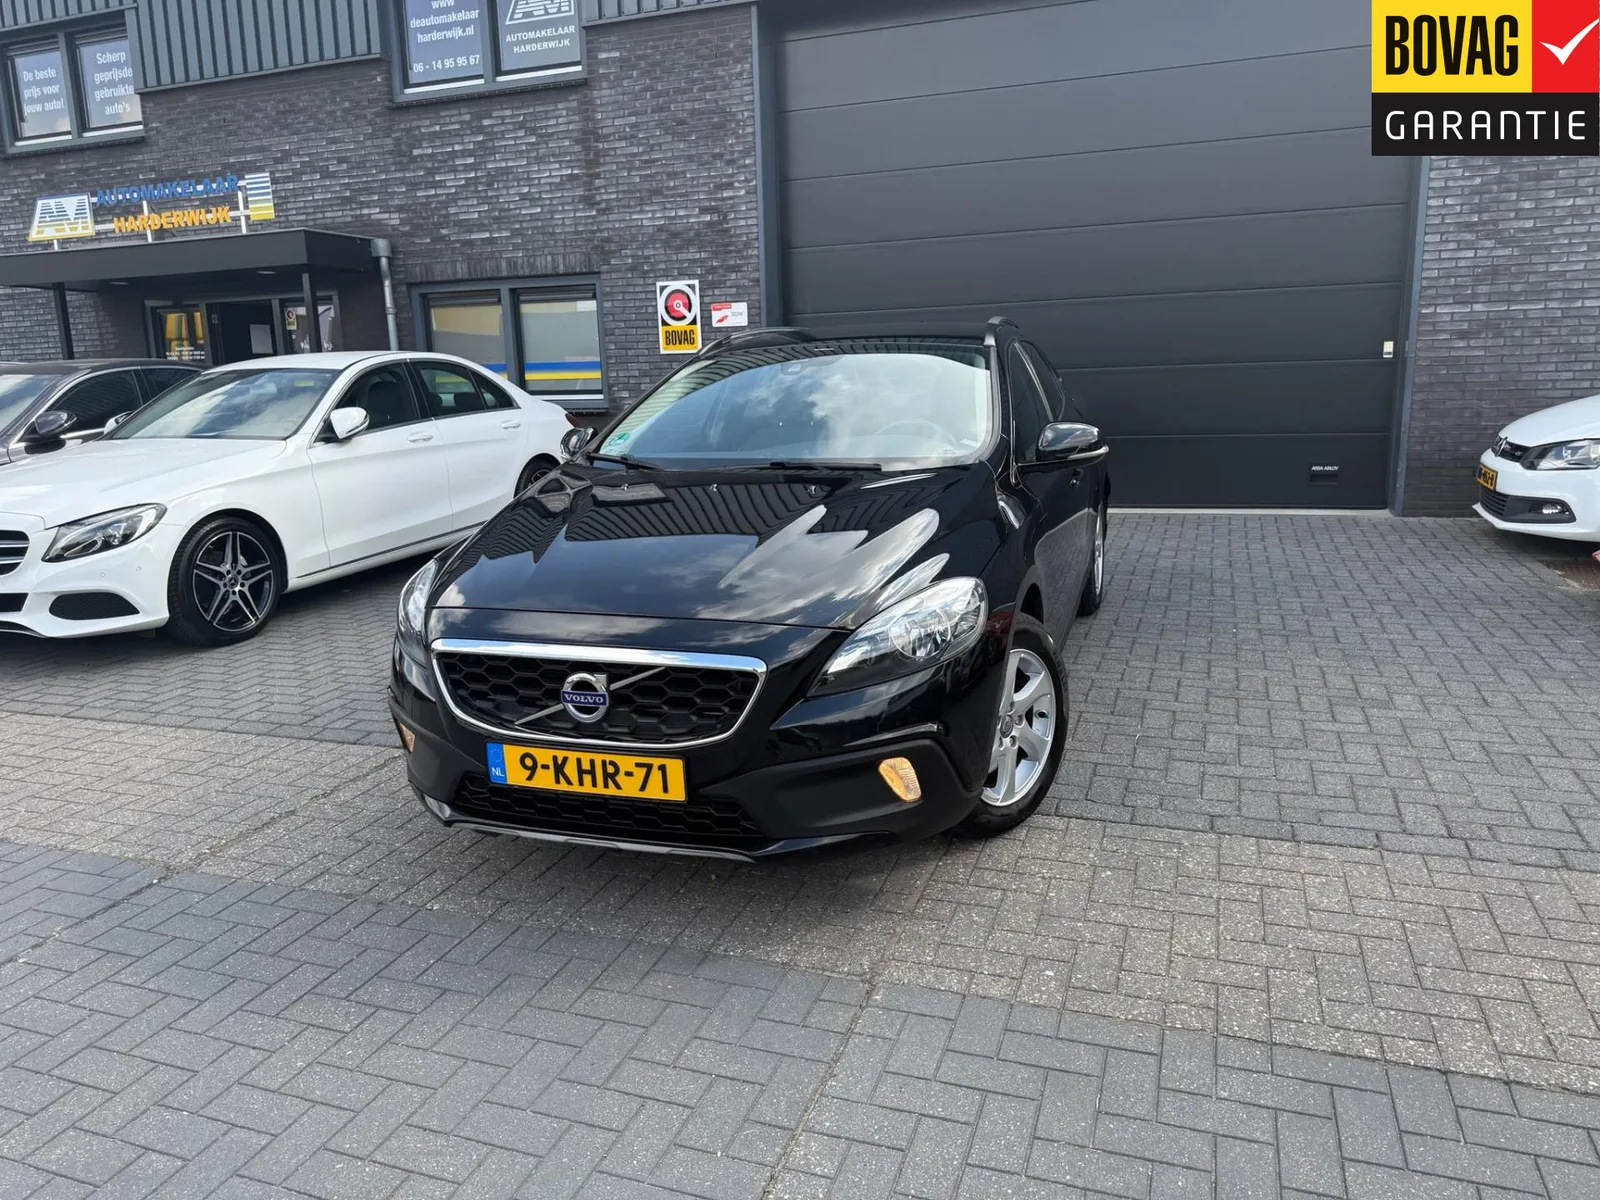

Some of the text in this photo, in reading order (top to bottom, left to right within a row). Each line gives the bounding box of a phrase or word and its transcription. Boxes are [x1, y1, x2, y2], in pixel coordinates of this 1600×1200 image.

[431, 0, 455, 9] www
[410, 9, 480, 28] deautomakelaar
[417, 24, 475, 43] harderwijk.nl
[506, 25, 576, 43] AUTOMAKELAAR
[513, 38, 571, 54] HARDERWIJK
[96, 51, 126, 65] Scherp
[413, 62, 424, 73] 06
[432, 60, 443, 71] 14
[444, 58, 455, 69] 95
[456, 56, 468, 67] 95
[469, 54, 480, 65] 67
[23, 67, 56, 82] De beste
[94, 66, 133, 84] geprijsde
[24, 85, 60, 101] prijs voor
[94, 84, 134, 102] gebruikte
[23, 98, 65, 116] jouw auto!
[104, 101, 131, 115] auto's
[95, 174, 239, 207] AUTOMAKELAAR
[112, 206, 232, 234] HARDERWIJK
[665, 329, 696, 346] BOVAG
[563, 693, 604, 704] VOLVO
[491, 766, 505, 777] NL
[519, 752, 669, 794] 9-KHR-71
